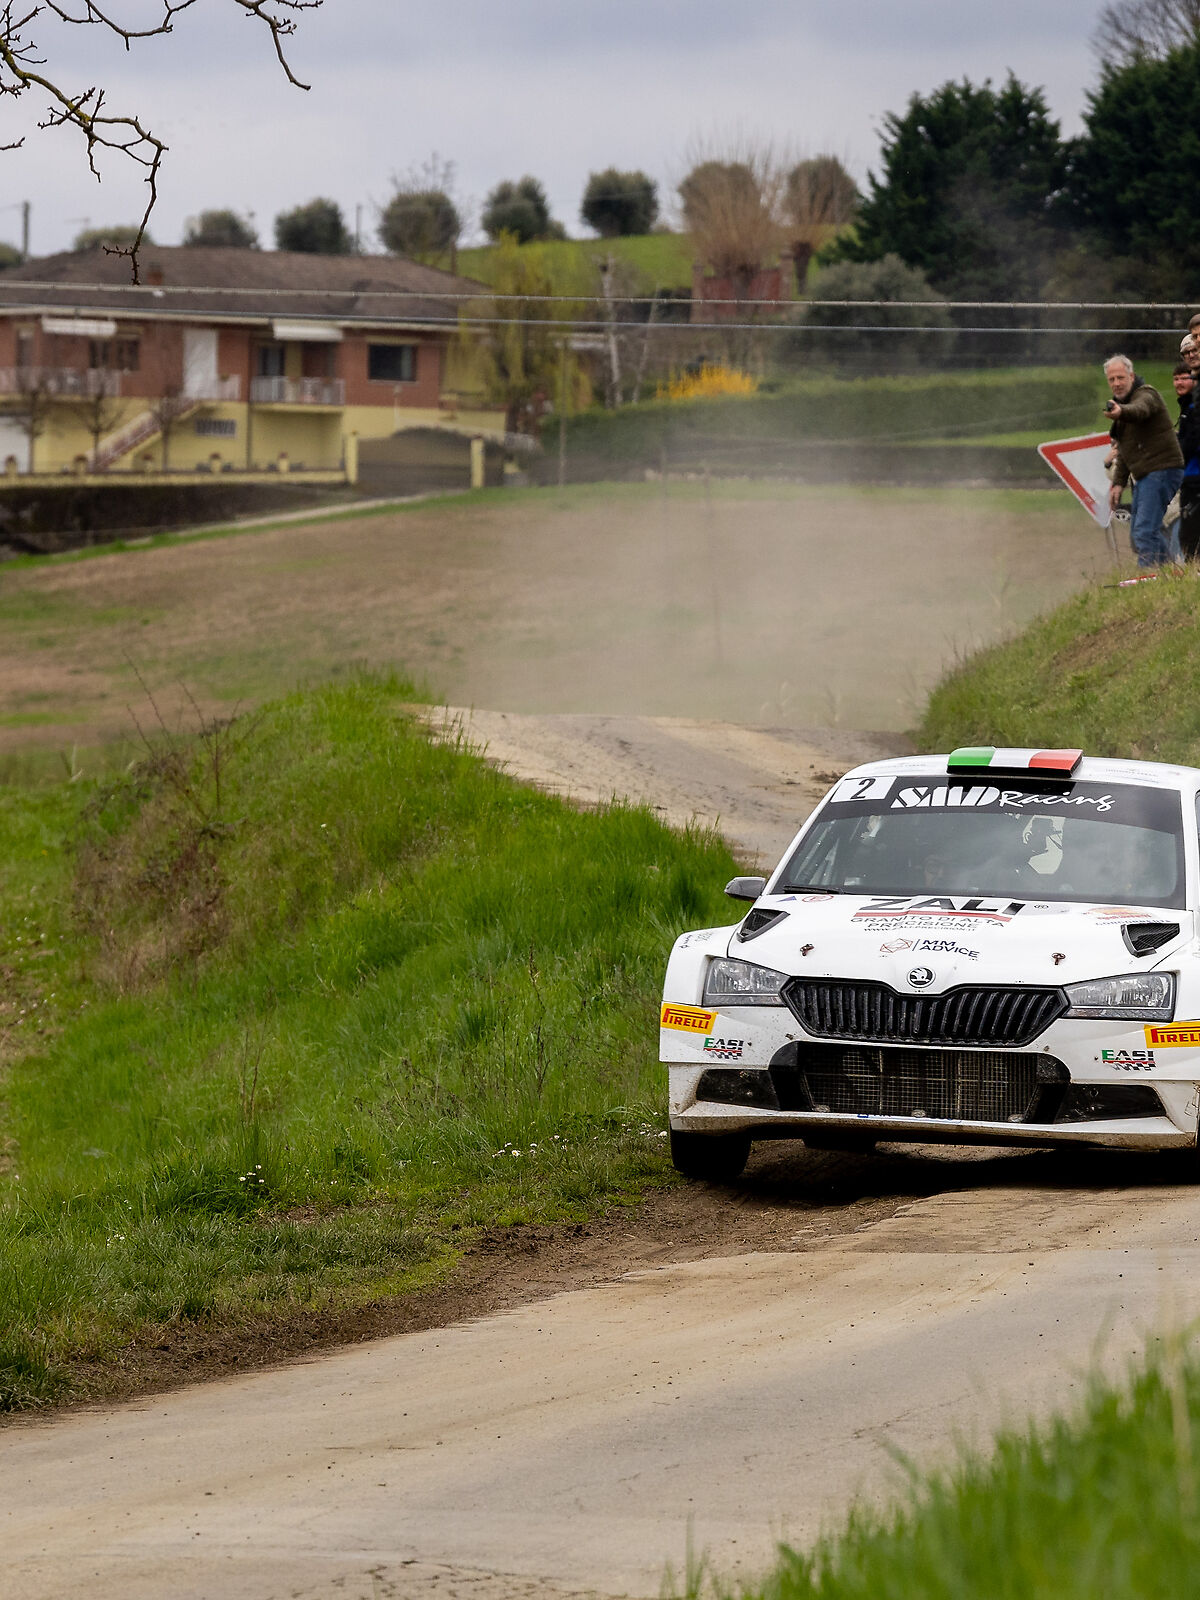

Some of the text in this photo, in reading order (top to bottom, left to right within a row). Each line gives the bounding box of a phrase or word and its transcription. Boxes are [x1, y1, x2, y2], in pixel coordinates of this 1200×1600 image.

[850, 777, 876, 800] 2
[998, 790, 1116, 812] Racing
[858, 897, 1026, 916] ZALI
[850, 915, 932, 923] GRANITO
[960, 917, 1004, 928] ALTA
[868, 920, 979, 929] PRECISIONE
[919, 944, 980, 959] ADVICE
[662, 1008, 712, 1029] PIRELLI
[703, 1037, 744, 1050] EASI
[1101, 1049, 1154, 1061] EASI
